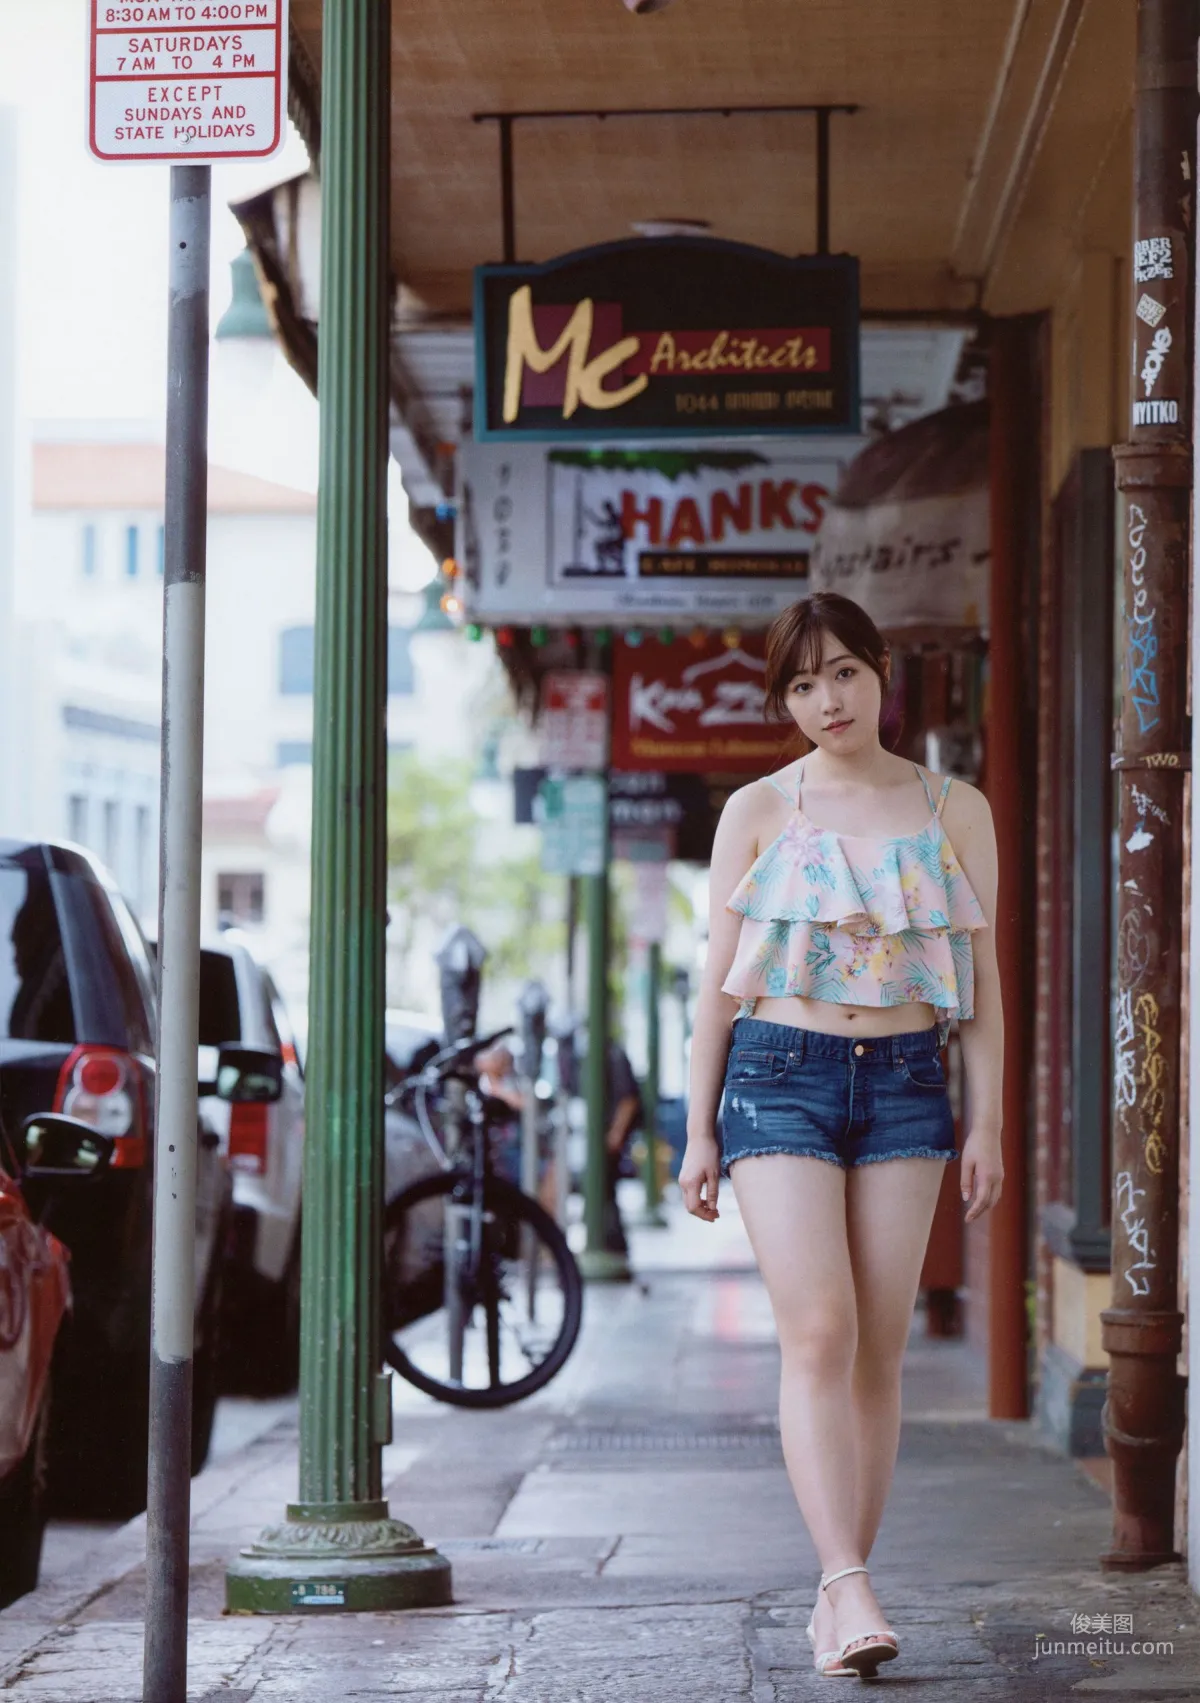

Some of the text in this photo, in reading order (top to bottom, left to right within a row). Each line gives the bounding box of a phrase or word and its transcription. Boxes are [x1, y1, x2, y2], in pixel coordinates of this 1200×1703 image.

[105, 4, 267, 22] 8:30 AM TO 4:00 PM
[128, 35, 243, 53] SATURDAYS
[117, 54, 255, 71] 7 AM TO 4 PM
[148, 85, 222, 103] EXCEPT
[124, 105, 246, 121] SUNDAYS AND
[114, 124, 255, 140] STATE HOLIDAYS
[502, 284, 818, 424] Mc Architects
[620, 478, 831, 549] HANKS
